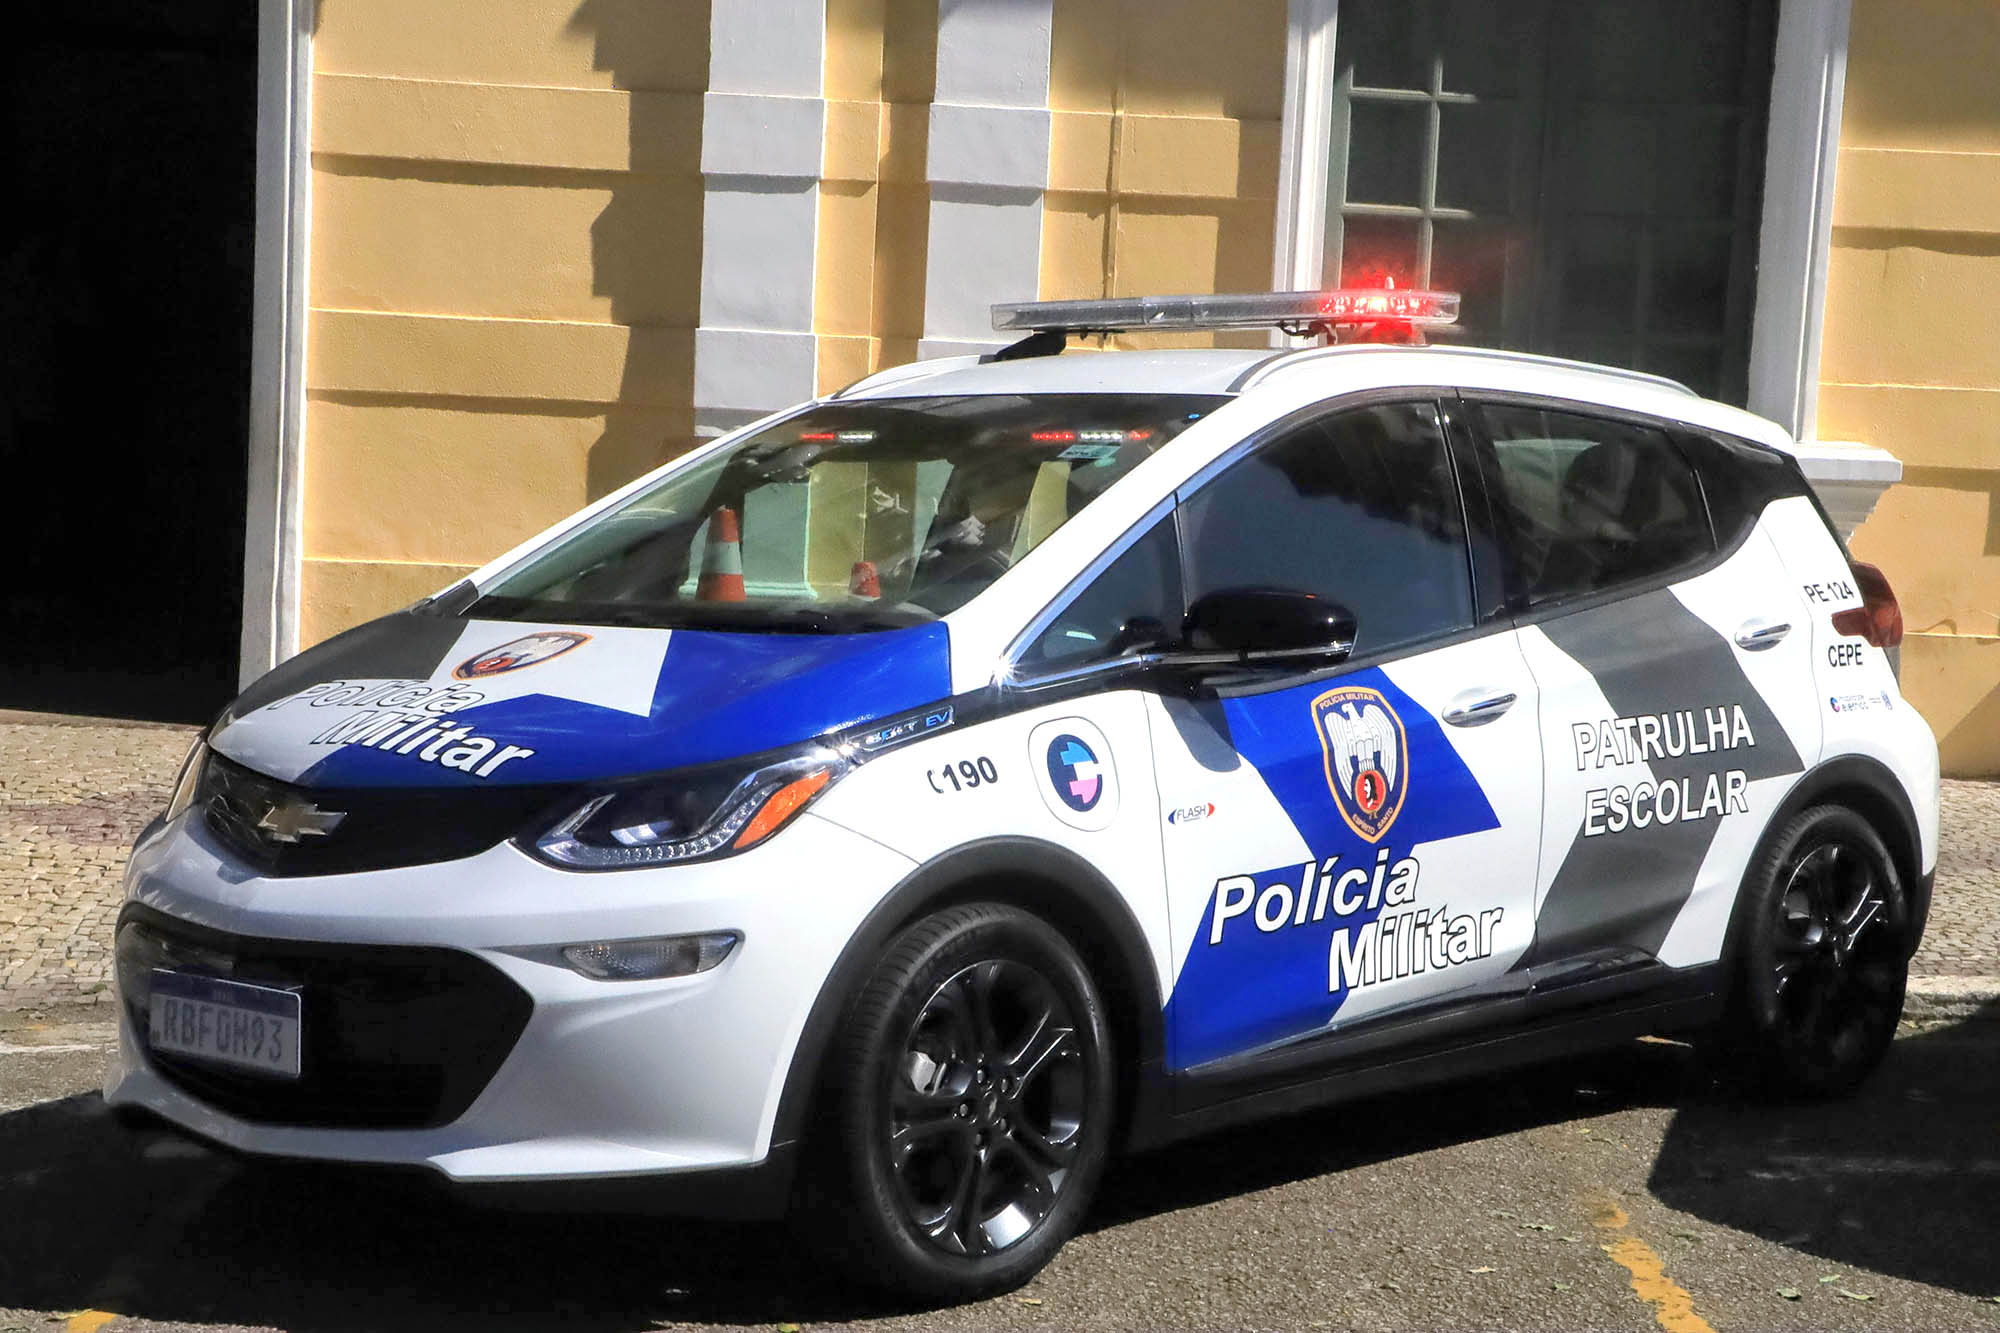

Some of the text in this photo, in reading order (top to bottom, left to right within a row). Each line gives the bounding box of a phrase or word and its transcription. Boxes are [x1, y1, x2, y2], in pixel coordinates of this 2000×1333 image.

[1803, 580, 1854, 604] PE 124
[1828, 643, 1863, 668] CEPE
[1345, 692, 1375, 702] MILITAR
[925, 711, 949, 727] EV
[310, 710, 536, 778] Militar
[1571, 704, 1756, 772] PATRULHA
[942, 756, 998, 791] 190
[1177, 804, 1206, 820] FLASH
[1377, 806, 1393, 829] SANTO
[1584, 769, 1749, 837] ESCOLAR
[1208, 847, 1420, 946] Polícia
[1327, 904, 1505, 994] Militar
